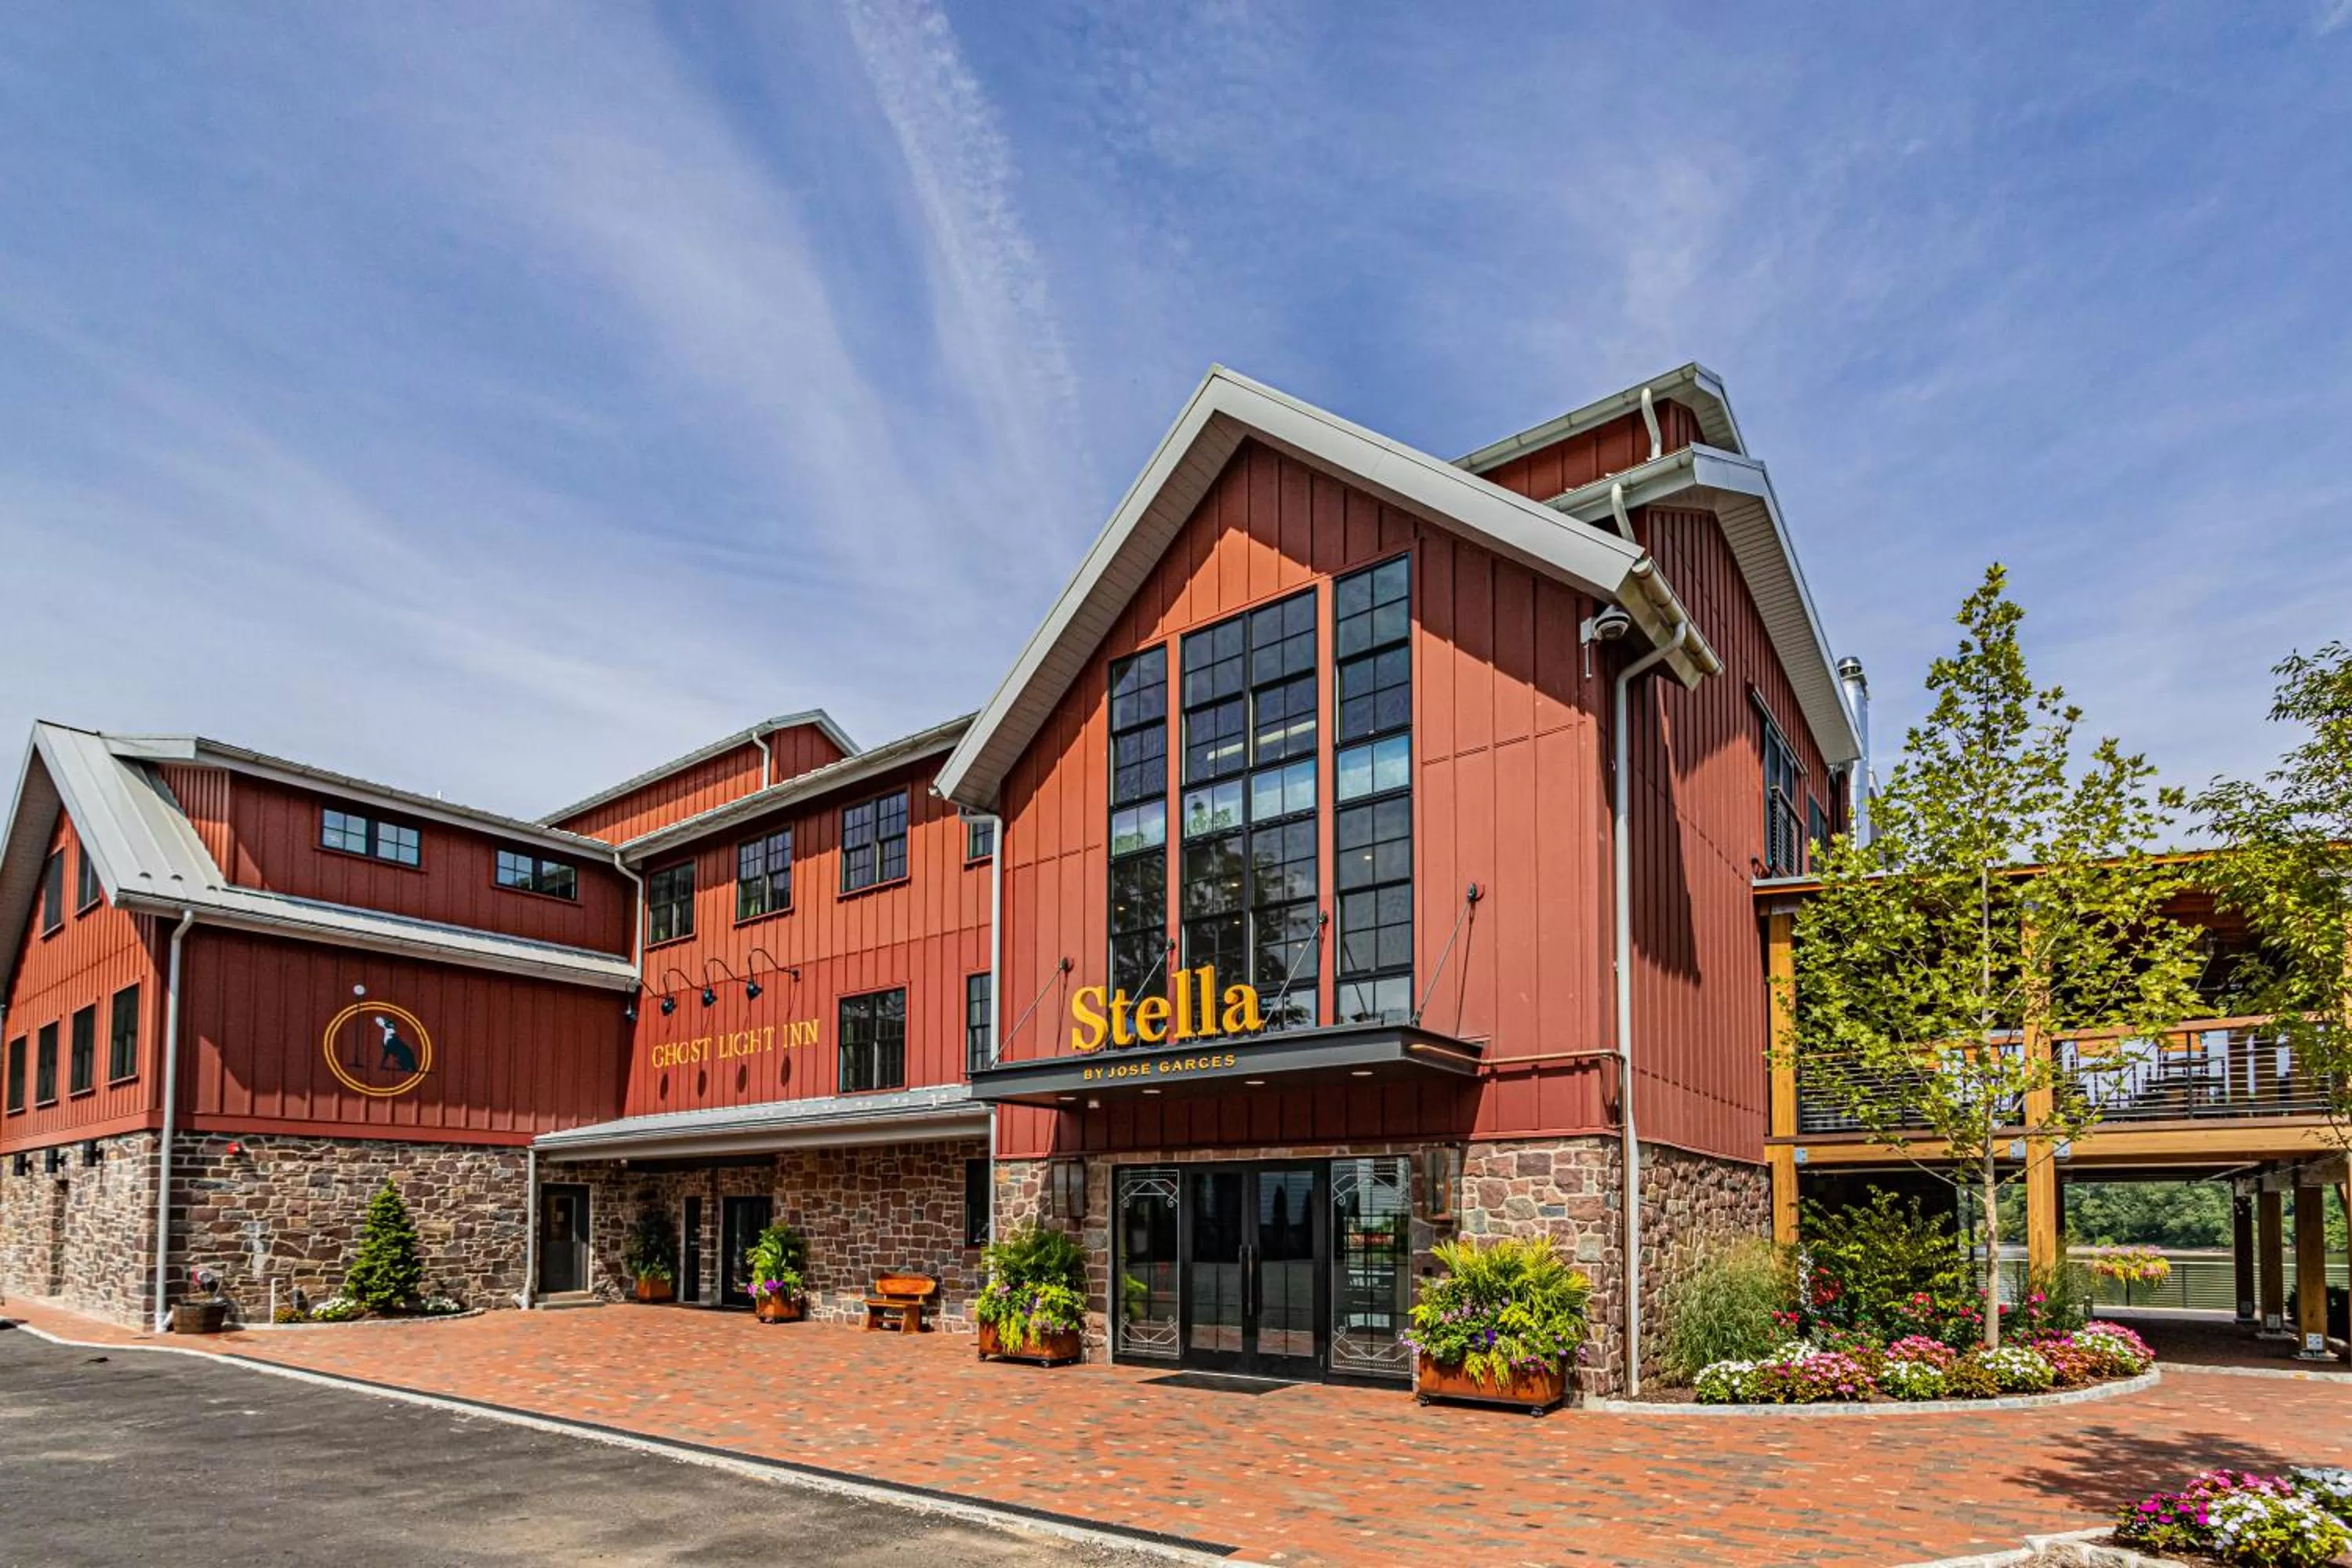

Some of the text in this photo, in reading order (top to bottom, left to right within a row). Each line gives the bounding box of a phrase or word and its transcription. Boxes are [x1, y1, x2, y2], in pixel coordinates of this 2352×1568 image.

[1072, 964, 1265, 1051] Stella
[652, 1018, 818, 1069] GHOST LIGHT INN
[1083, 1054, 1236, 1080] BY JOSE GARCES
